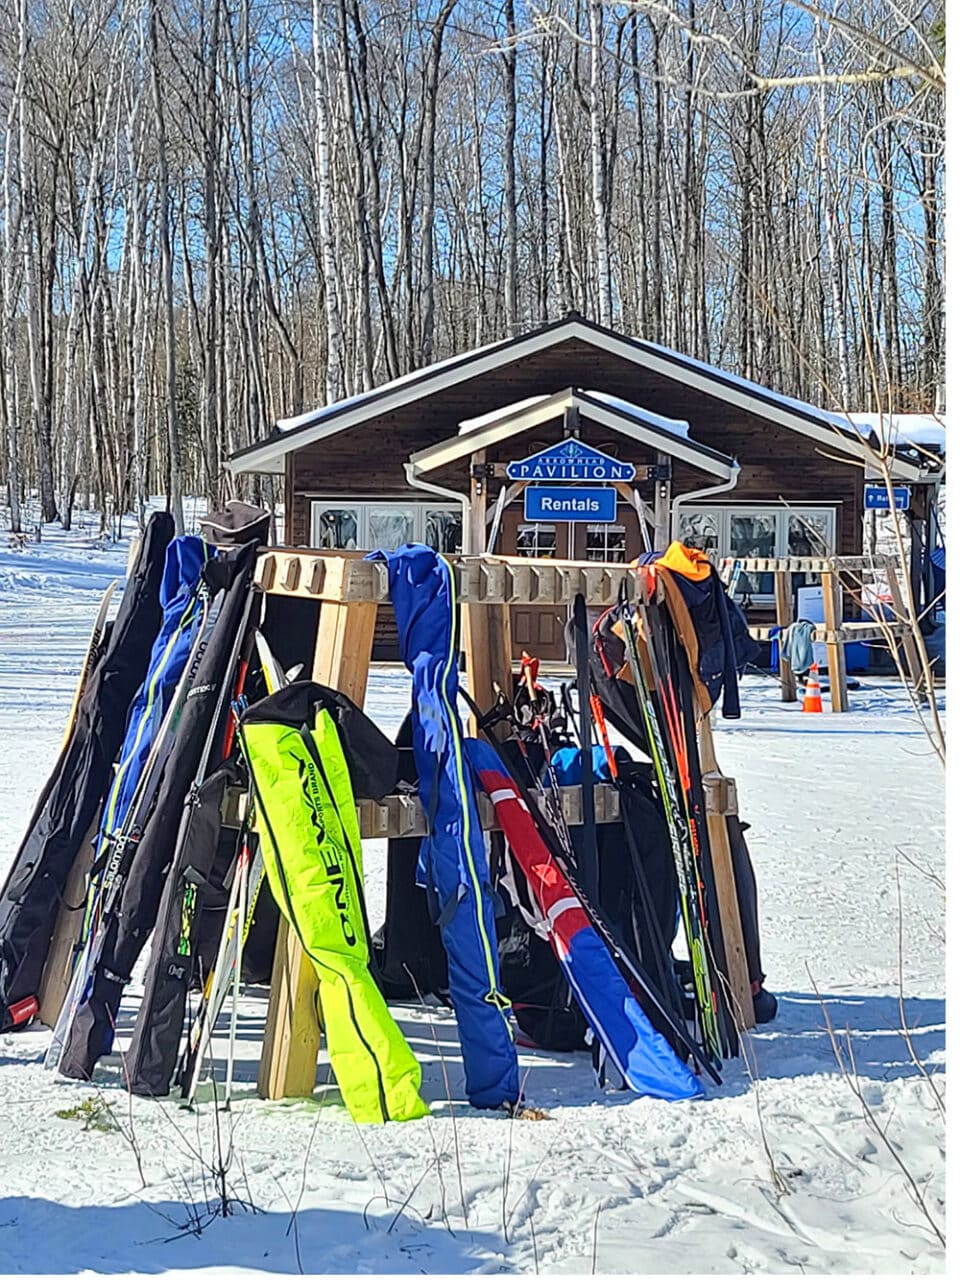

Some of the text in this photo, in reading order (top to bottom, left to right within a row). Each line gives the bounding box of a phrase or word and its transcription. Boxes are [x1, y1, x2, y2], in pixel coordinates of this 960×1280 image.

[521, 466, 623, 478] PAVILION
[541, 497, 599, 512] Rentals
[307, 762, 319, 795] BRAND
